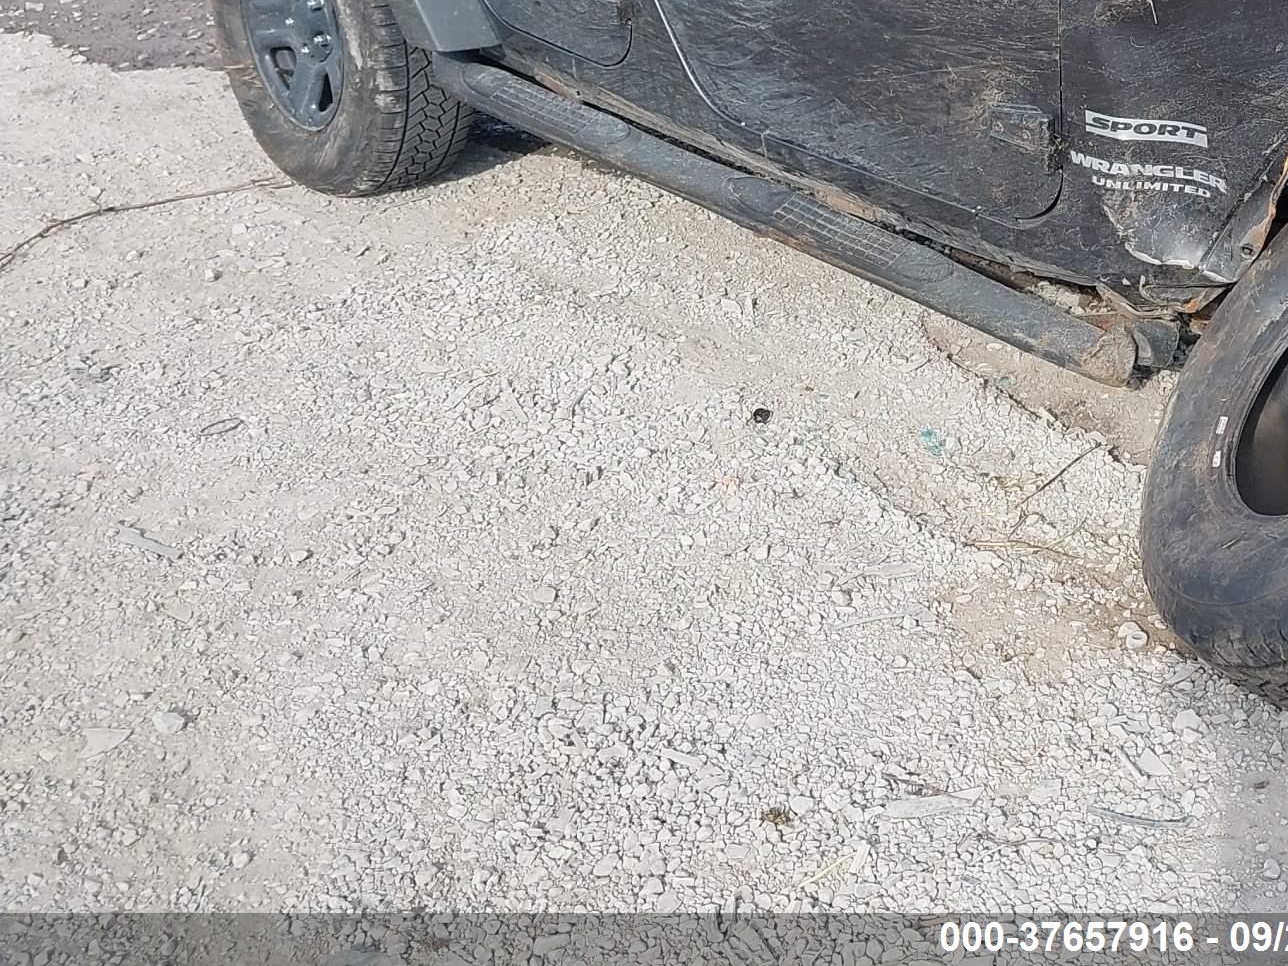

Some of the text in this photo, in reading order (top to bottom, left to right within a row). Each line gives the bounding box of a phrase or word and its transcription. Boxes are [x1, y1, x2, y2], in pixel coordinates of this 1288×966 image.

[1087, 116, 1207, 140] SPORT
[1070, 150, 1227, 194] WRANGLER
[1092, 175, 1211, 198] UNLIMITED
